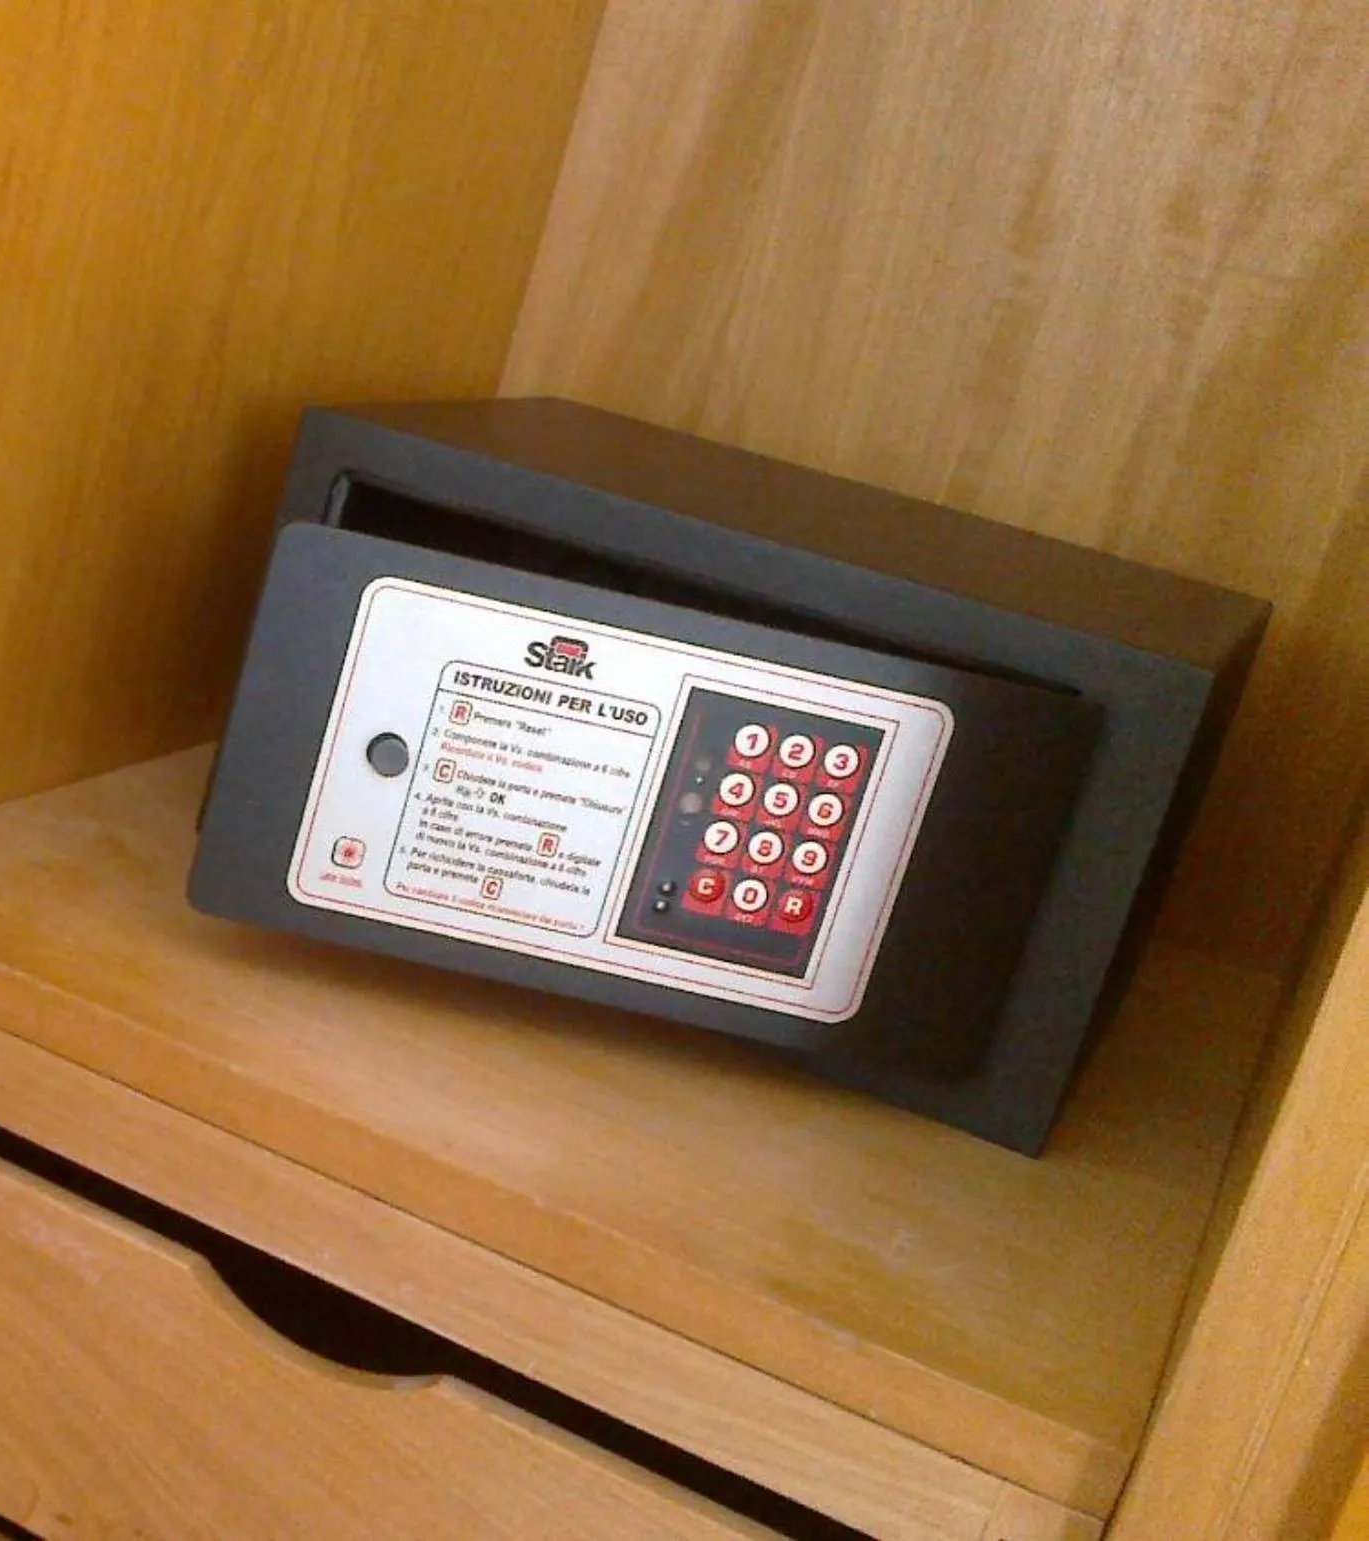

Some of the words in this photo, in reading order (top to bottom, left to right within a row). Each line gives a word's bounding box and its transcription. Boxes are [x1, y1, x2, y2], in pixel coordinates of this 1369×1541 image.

[454, 670, 554, 706] ISTRUZIONI
[557, 694, 593, 714] PER
[597, 702, 649, 727] L'USO
[454, 704, 466, 719] R
[746, 733, 759, 750] 1
[789, 743, 805, 761] 2
[833, 753, 850, 770] 3
[437, 763, 450, 778] C
[489, 791, 506, 805] OK
[729, 782, 745, 799] 4
[773, 792, 789, 809] 5
[817, 802, 833, 820] 6
[541, 837, 554, 851] R
[715, 829, 730, 846] 7
[757, 839, 773, 857] 8
[802, 849, 818, 867] 9
[484, 879, 498, 895] C
[698, 877, 714, 895] C
[742, 887, 760, 905] 0
[784, 896, 801, 916] R
